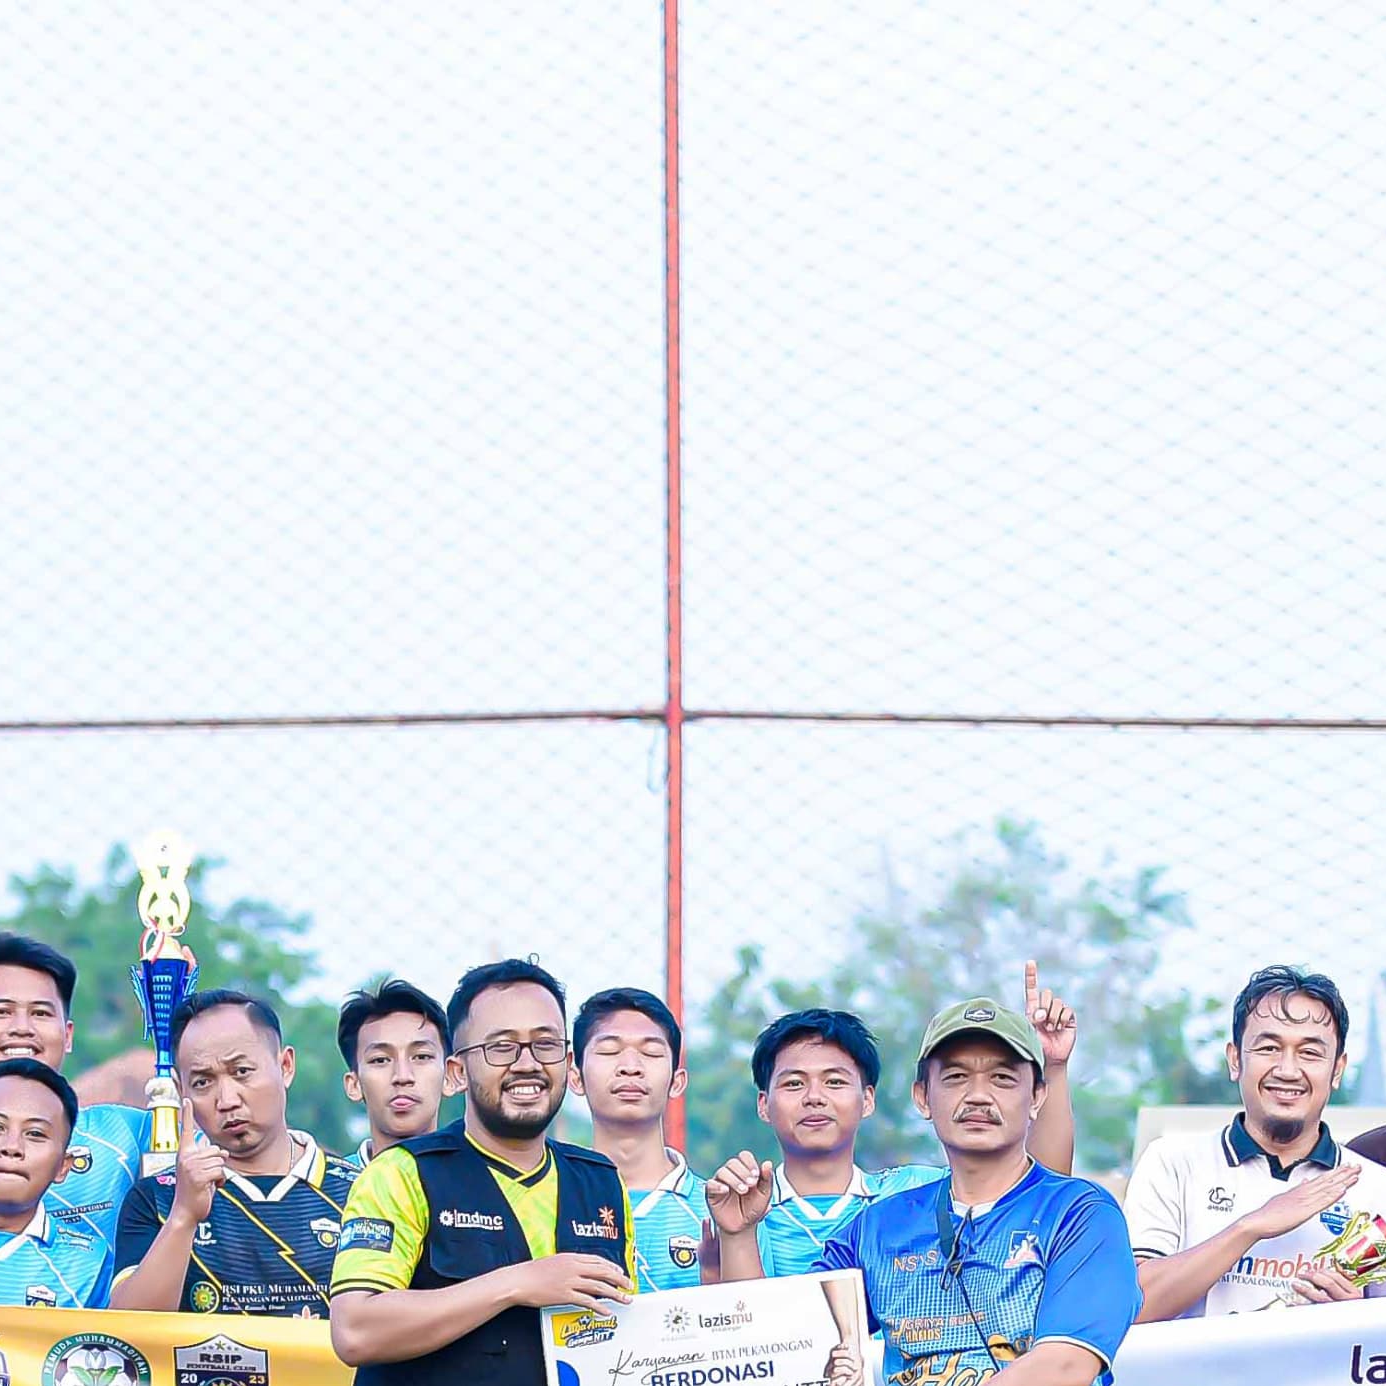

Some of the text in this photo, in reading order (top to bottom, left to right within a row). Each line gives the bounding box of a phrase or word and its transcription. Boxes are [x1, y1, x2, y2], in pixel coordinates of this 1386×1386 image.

[457, 1213, 503, 1226] mdmc
[571, 1220, 619, 1239] lazismu
[698, 1311, 753, 1329] lazismu
[738, 1338, 813, 1358] PEKALONGAN
[44, 1340, 72, 1375] PEMUDA
[199, 1353, 243, 1364] RSIP
[186, 1363, 230, 1371] FOOTBALL
[180, 1373, 266, 1385] 20 23
